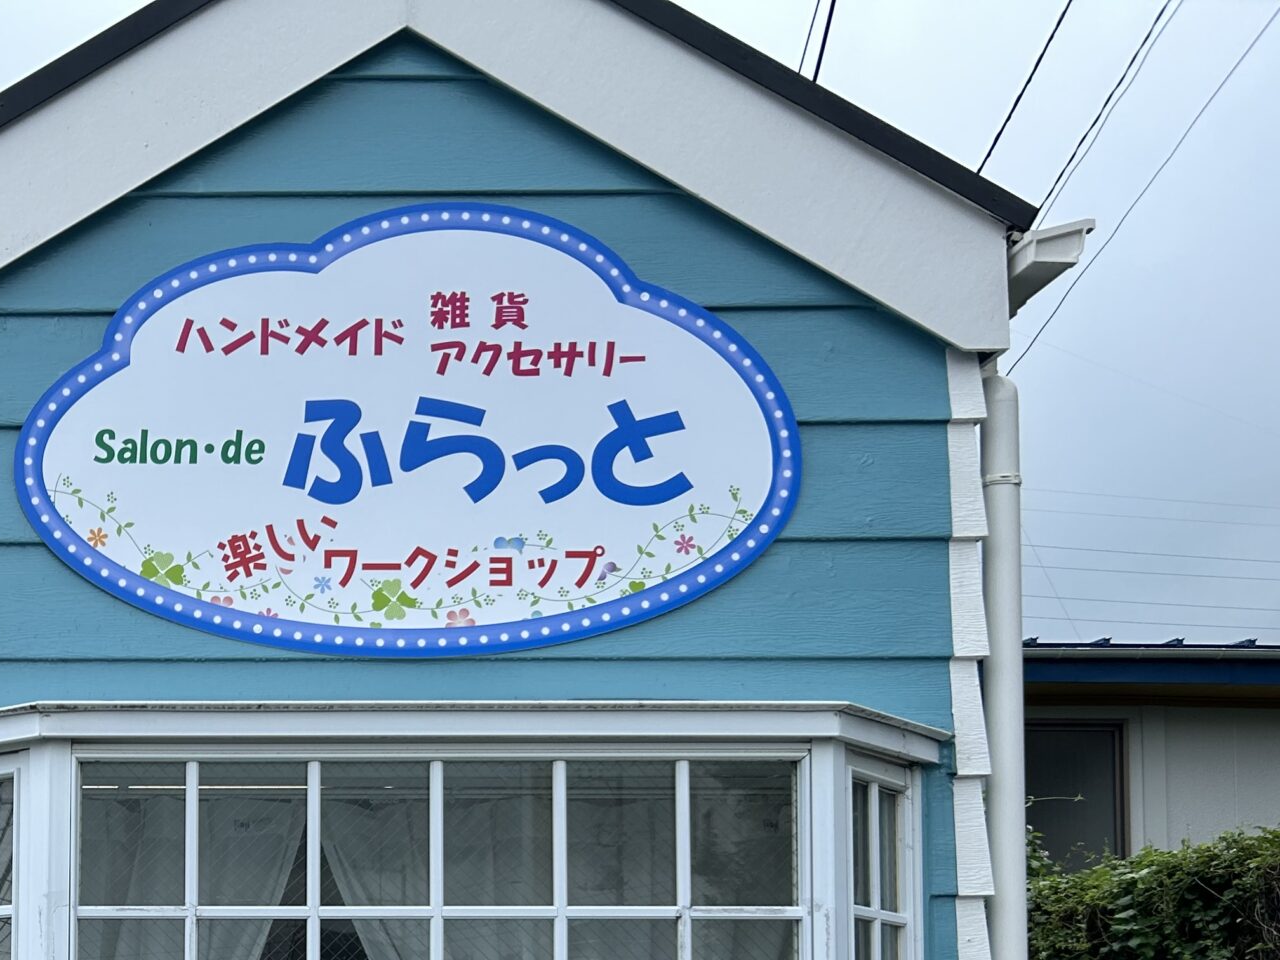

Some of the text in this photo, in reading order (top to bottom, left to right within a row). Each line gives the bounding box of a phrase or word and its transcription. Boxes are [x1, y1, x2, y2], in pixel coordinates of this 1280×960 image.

[176, 318, 404, 356] ハンドメイド
[431, 341, 645, 377] アクセサリー
[282, 396, 694, 506] ふらっと
[217, 515, 605, 589] 楽しい ワークショップ
